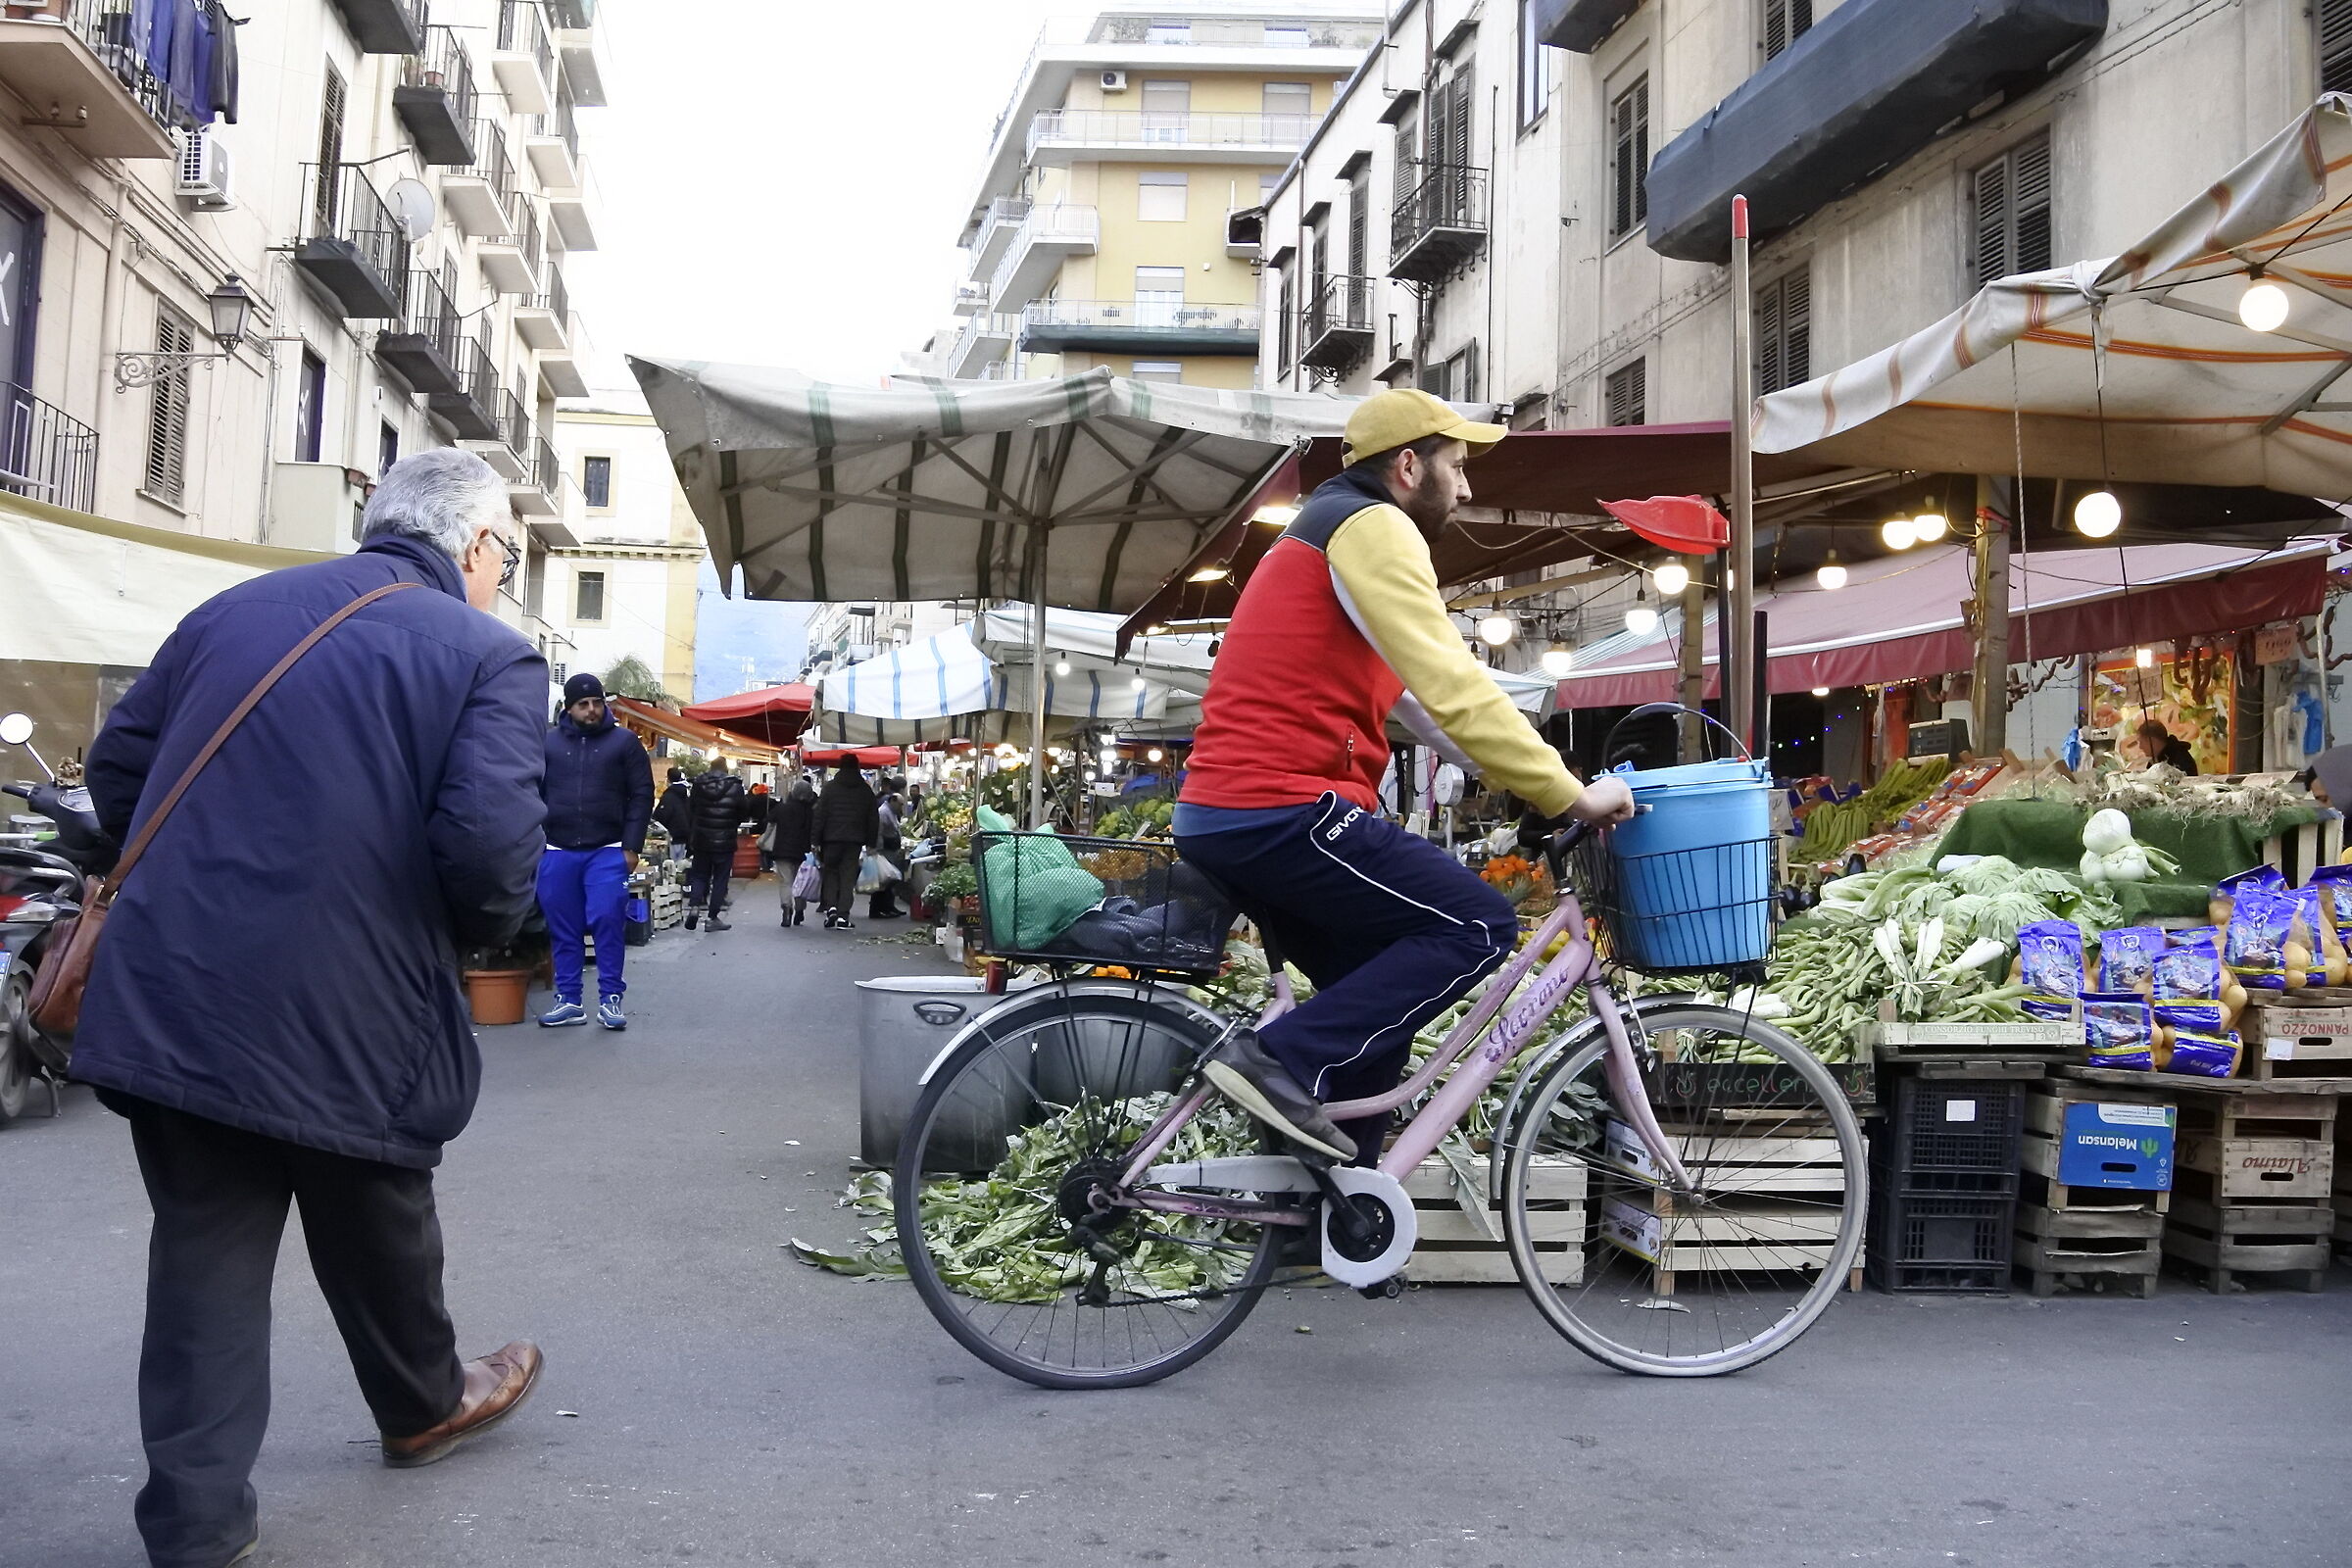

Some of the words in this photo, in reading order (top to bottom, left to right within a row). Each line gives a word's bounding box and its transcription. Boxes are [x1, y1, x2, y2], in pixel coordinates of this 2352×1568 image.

[2281, 1023, 2349, 1035] PANNOZZO
[2078, 1135, 2137, 1151] Melansan
[2242, 1156, 2316, 1174] Alaimo
